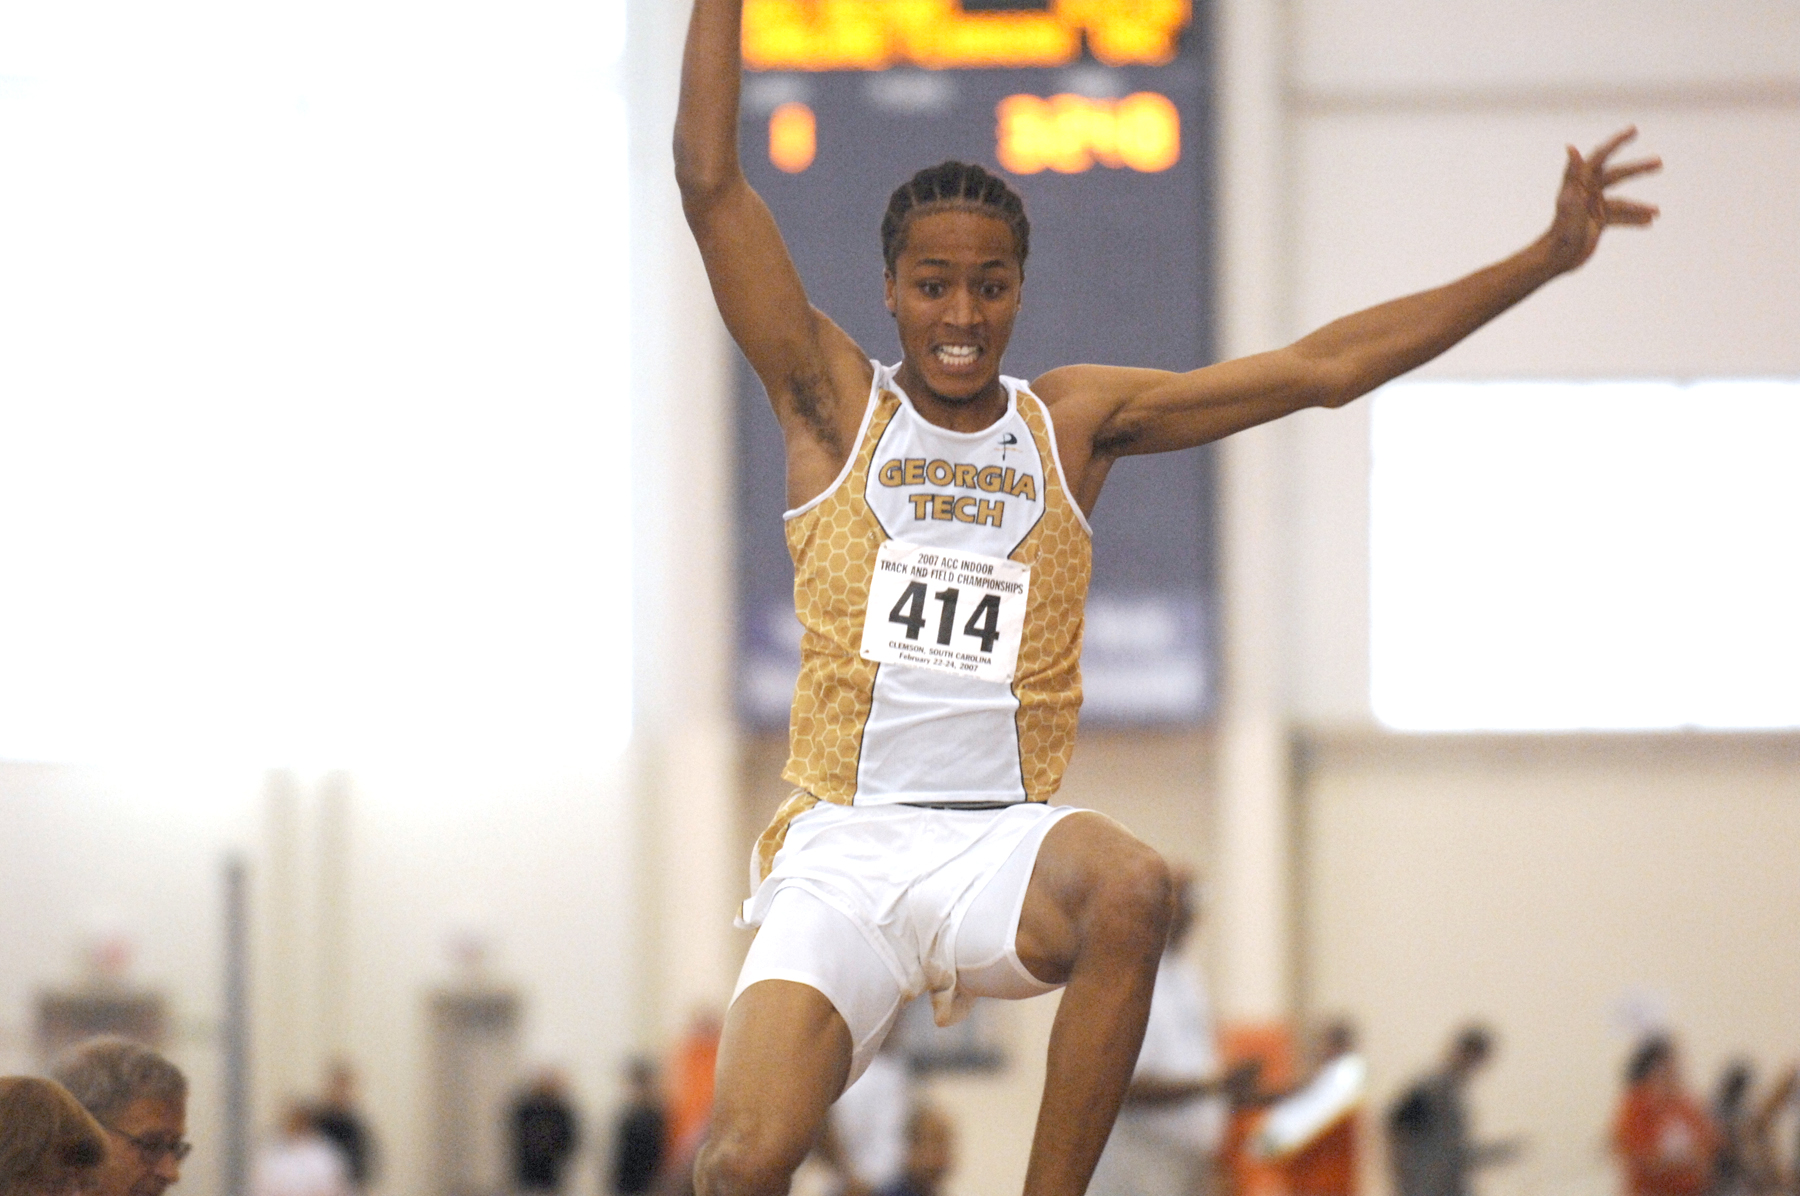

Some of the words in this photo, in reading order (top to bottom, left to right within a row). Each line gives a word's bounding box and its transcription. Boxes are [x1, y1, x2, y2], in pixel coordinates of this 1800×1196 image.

[878, 458, 1036, 502] GEORGIA
[908, 493, 1005, 528] TECH
[880, 559, 908, 574] TRACK
[910, 565, 928, 578] AND
[930, 569, 954, 583] FIELD
[957, 574, 1024, 595] CHAMPIONSHIPS
[918, 553, 939, 567] 2007
[941, 557, 959, 570] ACC
[961, 560, 994, 576] INDOOR
[888, 580, 1001, 653] 414
[888, 640, 926, 654] CLEMSON,
[929, 647, 954, 659] SOUTH
[955, 652, 992, 665] CAROLINA
[899, 652, 931, 665] February
[933, 657, 957, 670] 22-24,
[959, 662, 979, 673] 2007
